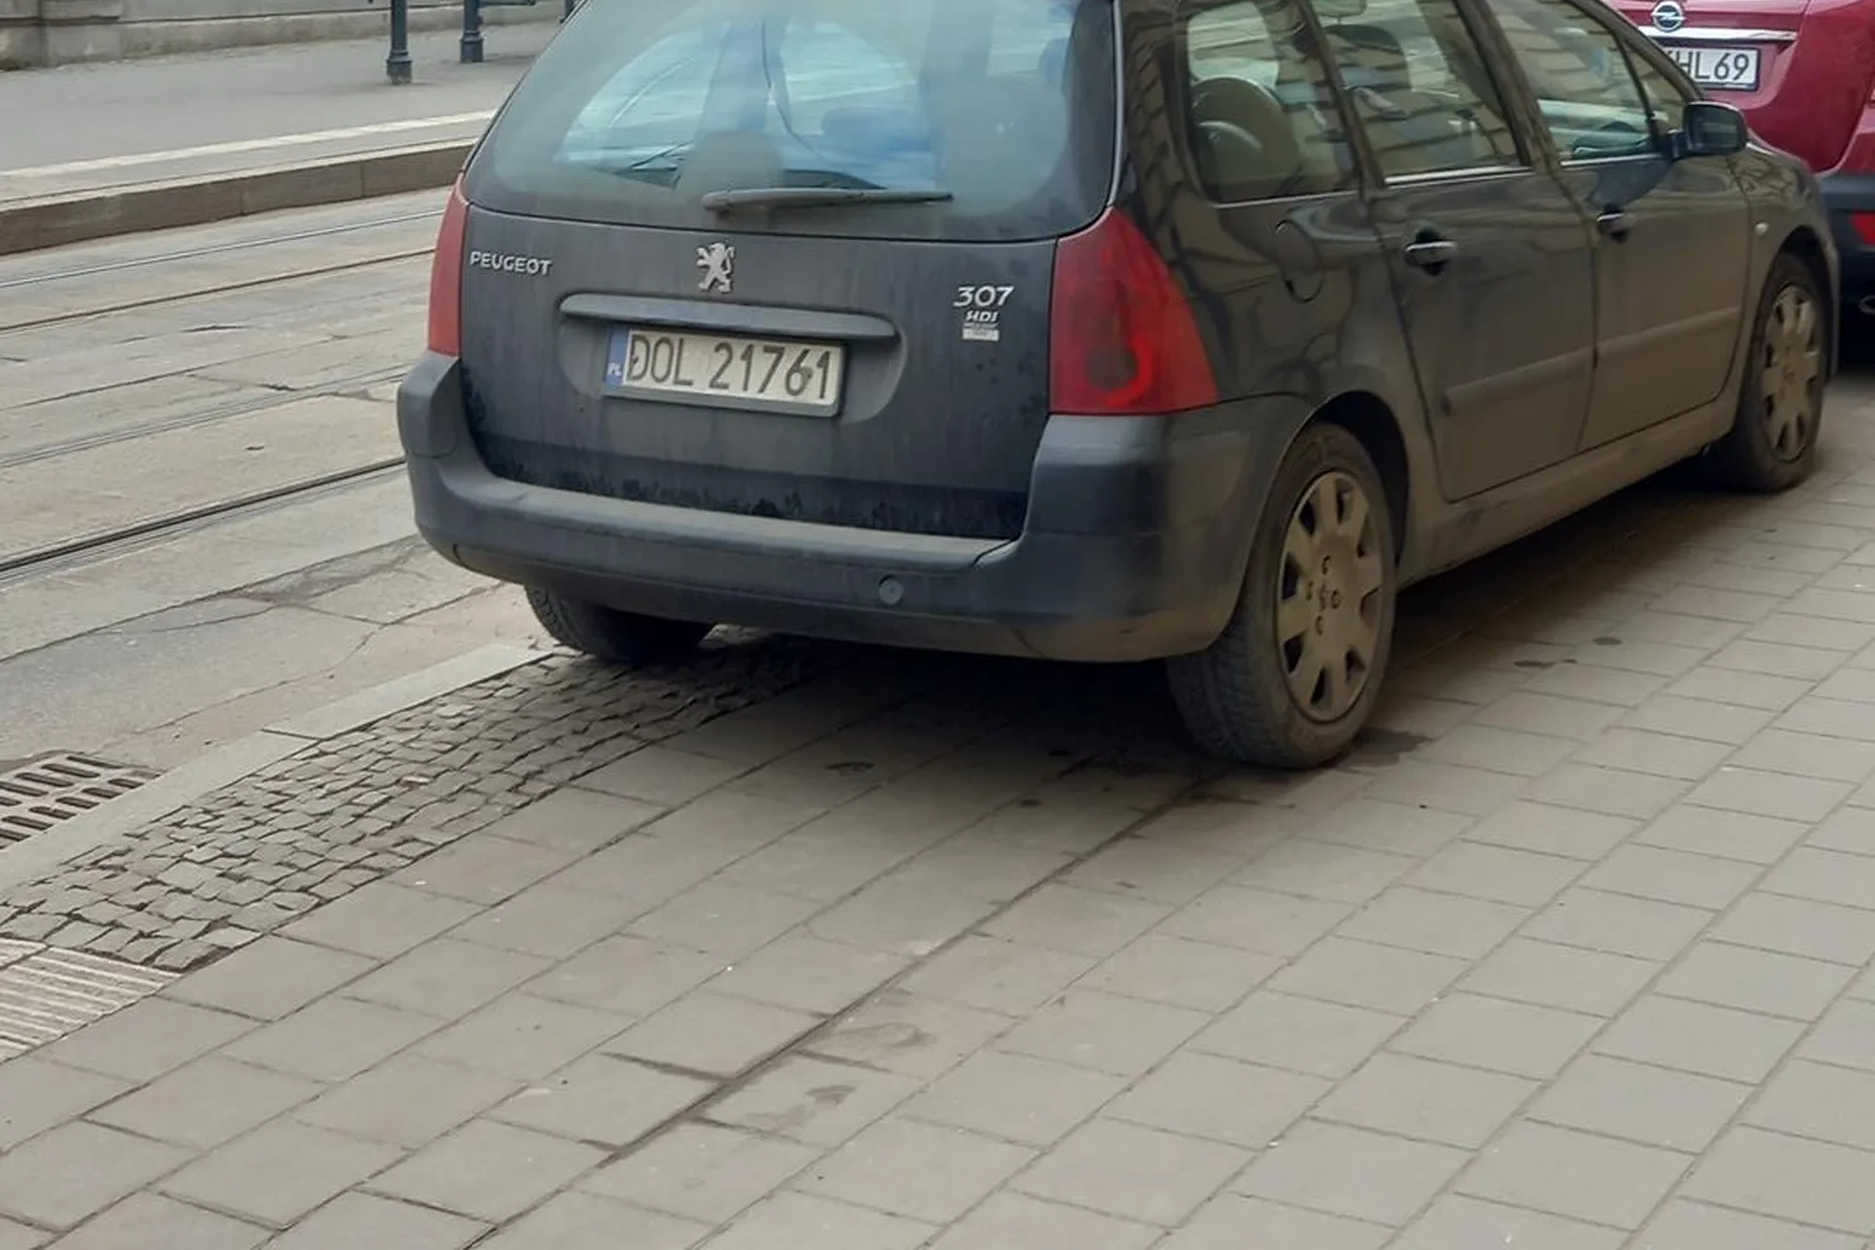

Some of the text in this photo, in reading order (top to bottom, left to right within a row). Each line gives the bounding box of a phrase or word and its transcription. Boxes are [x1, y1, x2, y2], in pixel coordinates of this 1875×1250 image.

[1668, 51, 1750, 81] HL69
[470, 250, 553, 275] PEUGEOT
[953, 285, 1015, 307] 307
[626, 333, 831, 400] DOL 21761
